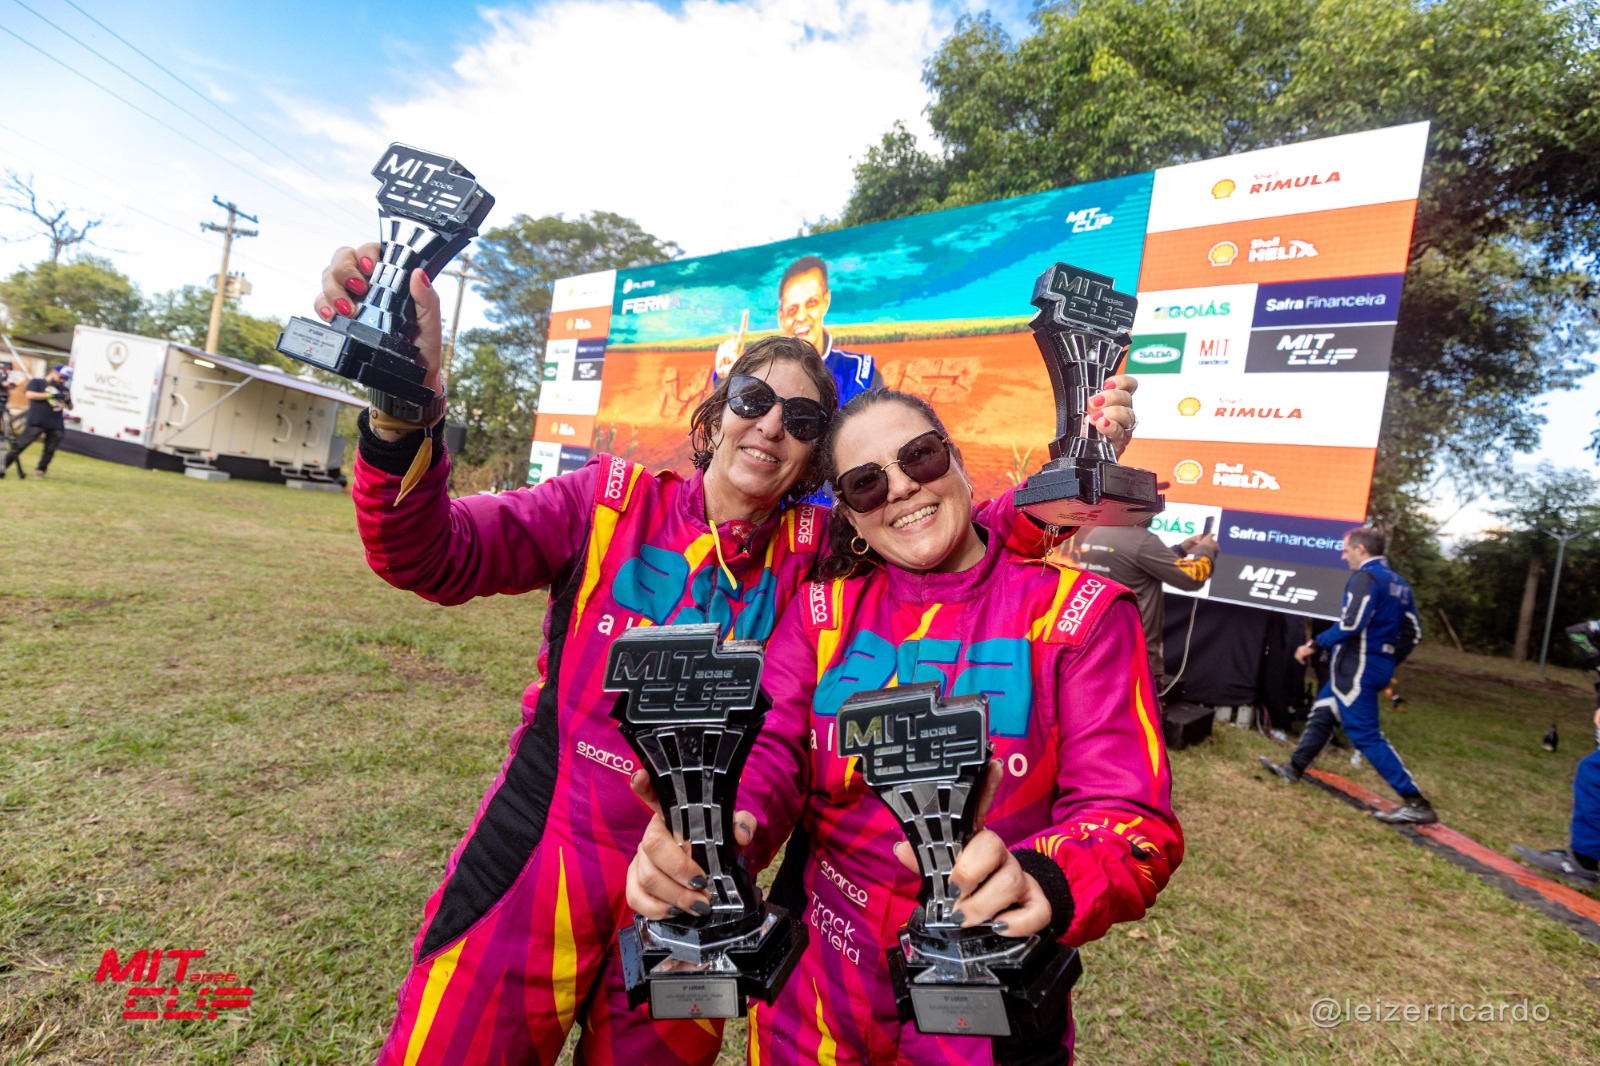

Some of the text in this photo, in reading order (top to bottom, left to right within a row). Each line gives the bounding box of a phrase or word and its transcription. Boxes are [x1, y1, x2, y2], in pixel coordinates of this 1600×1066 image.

[381, 153, 445, 184] MIT
[1249, 171, 1340, 194] RIMULA
[386, 180, 461, 211] CUP
[1066, 207, 1101, 223] MIT
[1072, 216, 1114, 233] CUP
[1248, 240, 1319, 262] HELIX
[1055, 271, 1111, 300] MIT
[1069, 296, 1133, 325] CUP
[1168, 300, 1231, 319] GOIÁS
[1265, 292, 1386, 312] Safra Financeira
[1199, 339, 1231, 356] MIT
[1276, 333, 1335, 350] MIT
[1287, 348, 1358, 365] CUP
[1214, 407, 1302, 418] RIMULA
[1212, 470, 1281, 490] HELIX
[1228, 525, 1344, 551] Safra Financeira
[1238, 565, 1296, 585] MIT
[1249, 582, 1318, 604] CUP
[1057, 579, 1106, 635] sparco
[612, 651, 733, 681] MIT 2026
[638, 682, 751, 711] CUP
[845, 709, 928, 749] MIT
[920, 725, 957, 739] 2026
[576, 741, 634, 776] sparco
[873, 737, 978, 776] CUP
[812, 891, 855, 943] Track
[811, 908, 859, 965] & Field
